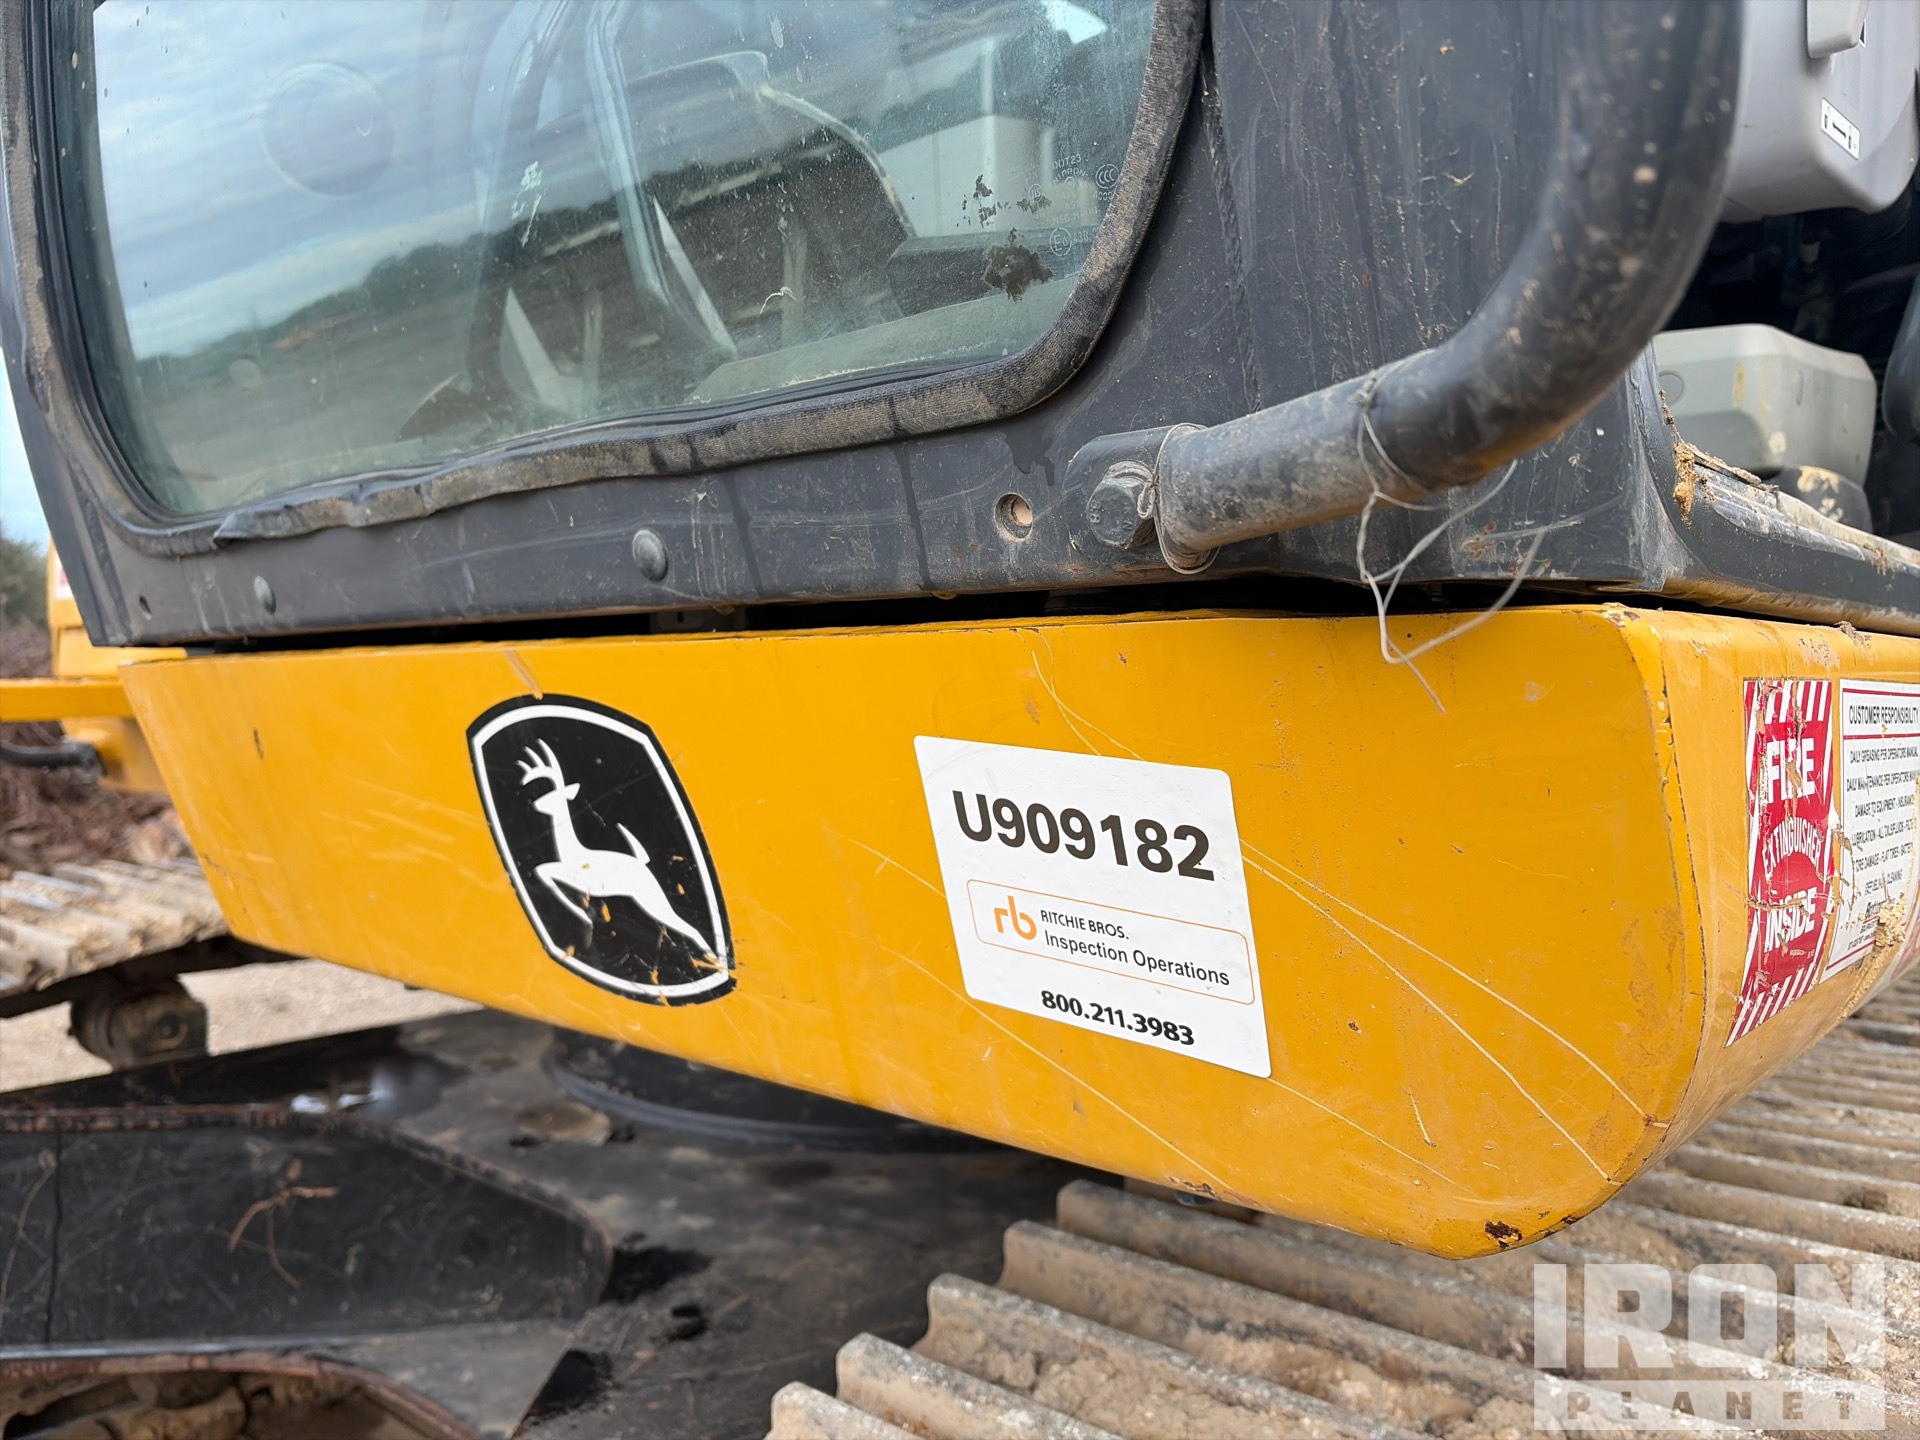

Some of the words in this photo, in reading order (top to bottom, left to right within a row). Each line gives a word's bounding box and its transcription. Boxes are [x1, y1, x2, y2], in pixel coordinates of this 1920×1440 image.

[1849, 705, 1880, 724] CUSTOMER
[1881, 705, 1919, 724] RESPONSIBILITY
[1766, 737, 1816, 804] FIRE
[952, 790, 1215, 882] U909182
[1762, 816, 1822, 881] EXTINGUISHER
[993, 895, 1037, 941] rb
[1040, 910, 1086, 931] RITCHIE
[1088, 920, 1130, 940] BROS.
[1764, 887, 1817, 953] INSIDE
[1044, 930, 1128, 964] Inspection
[1133, 949, 1231, 986] Operations
[1040, 989, 1196, 1046] 800.211.3983
